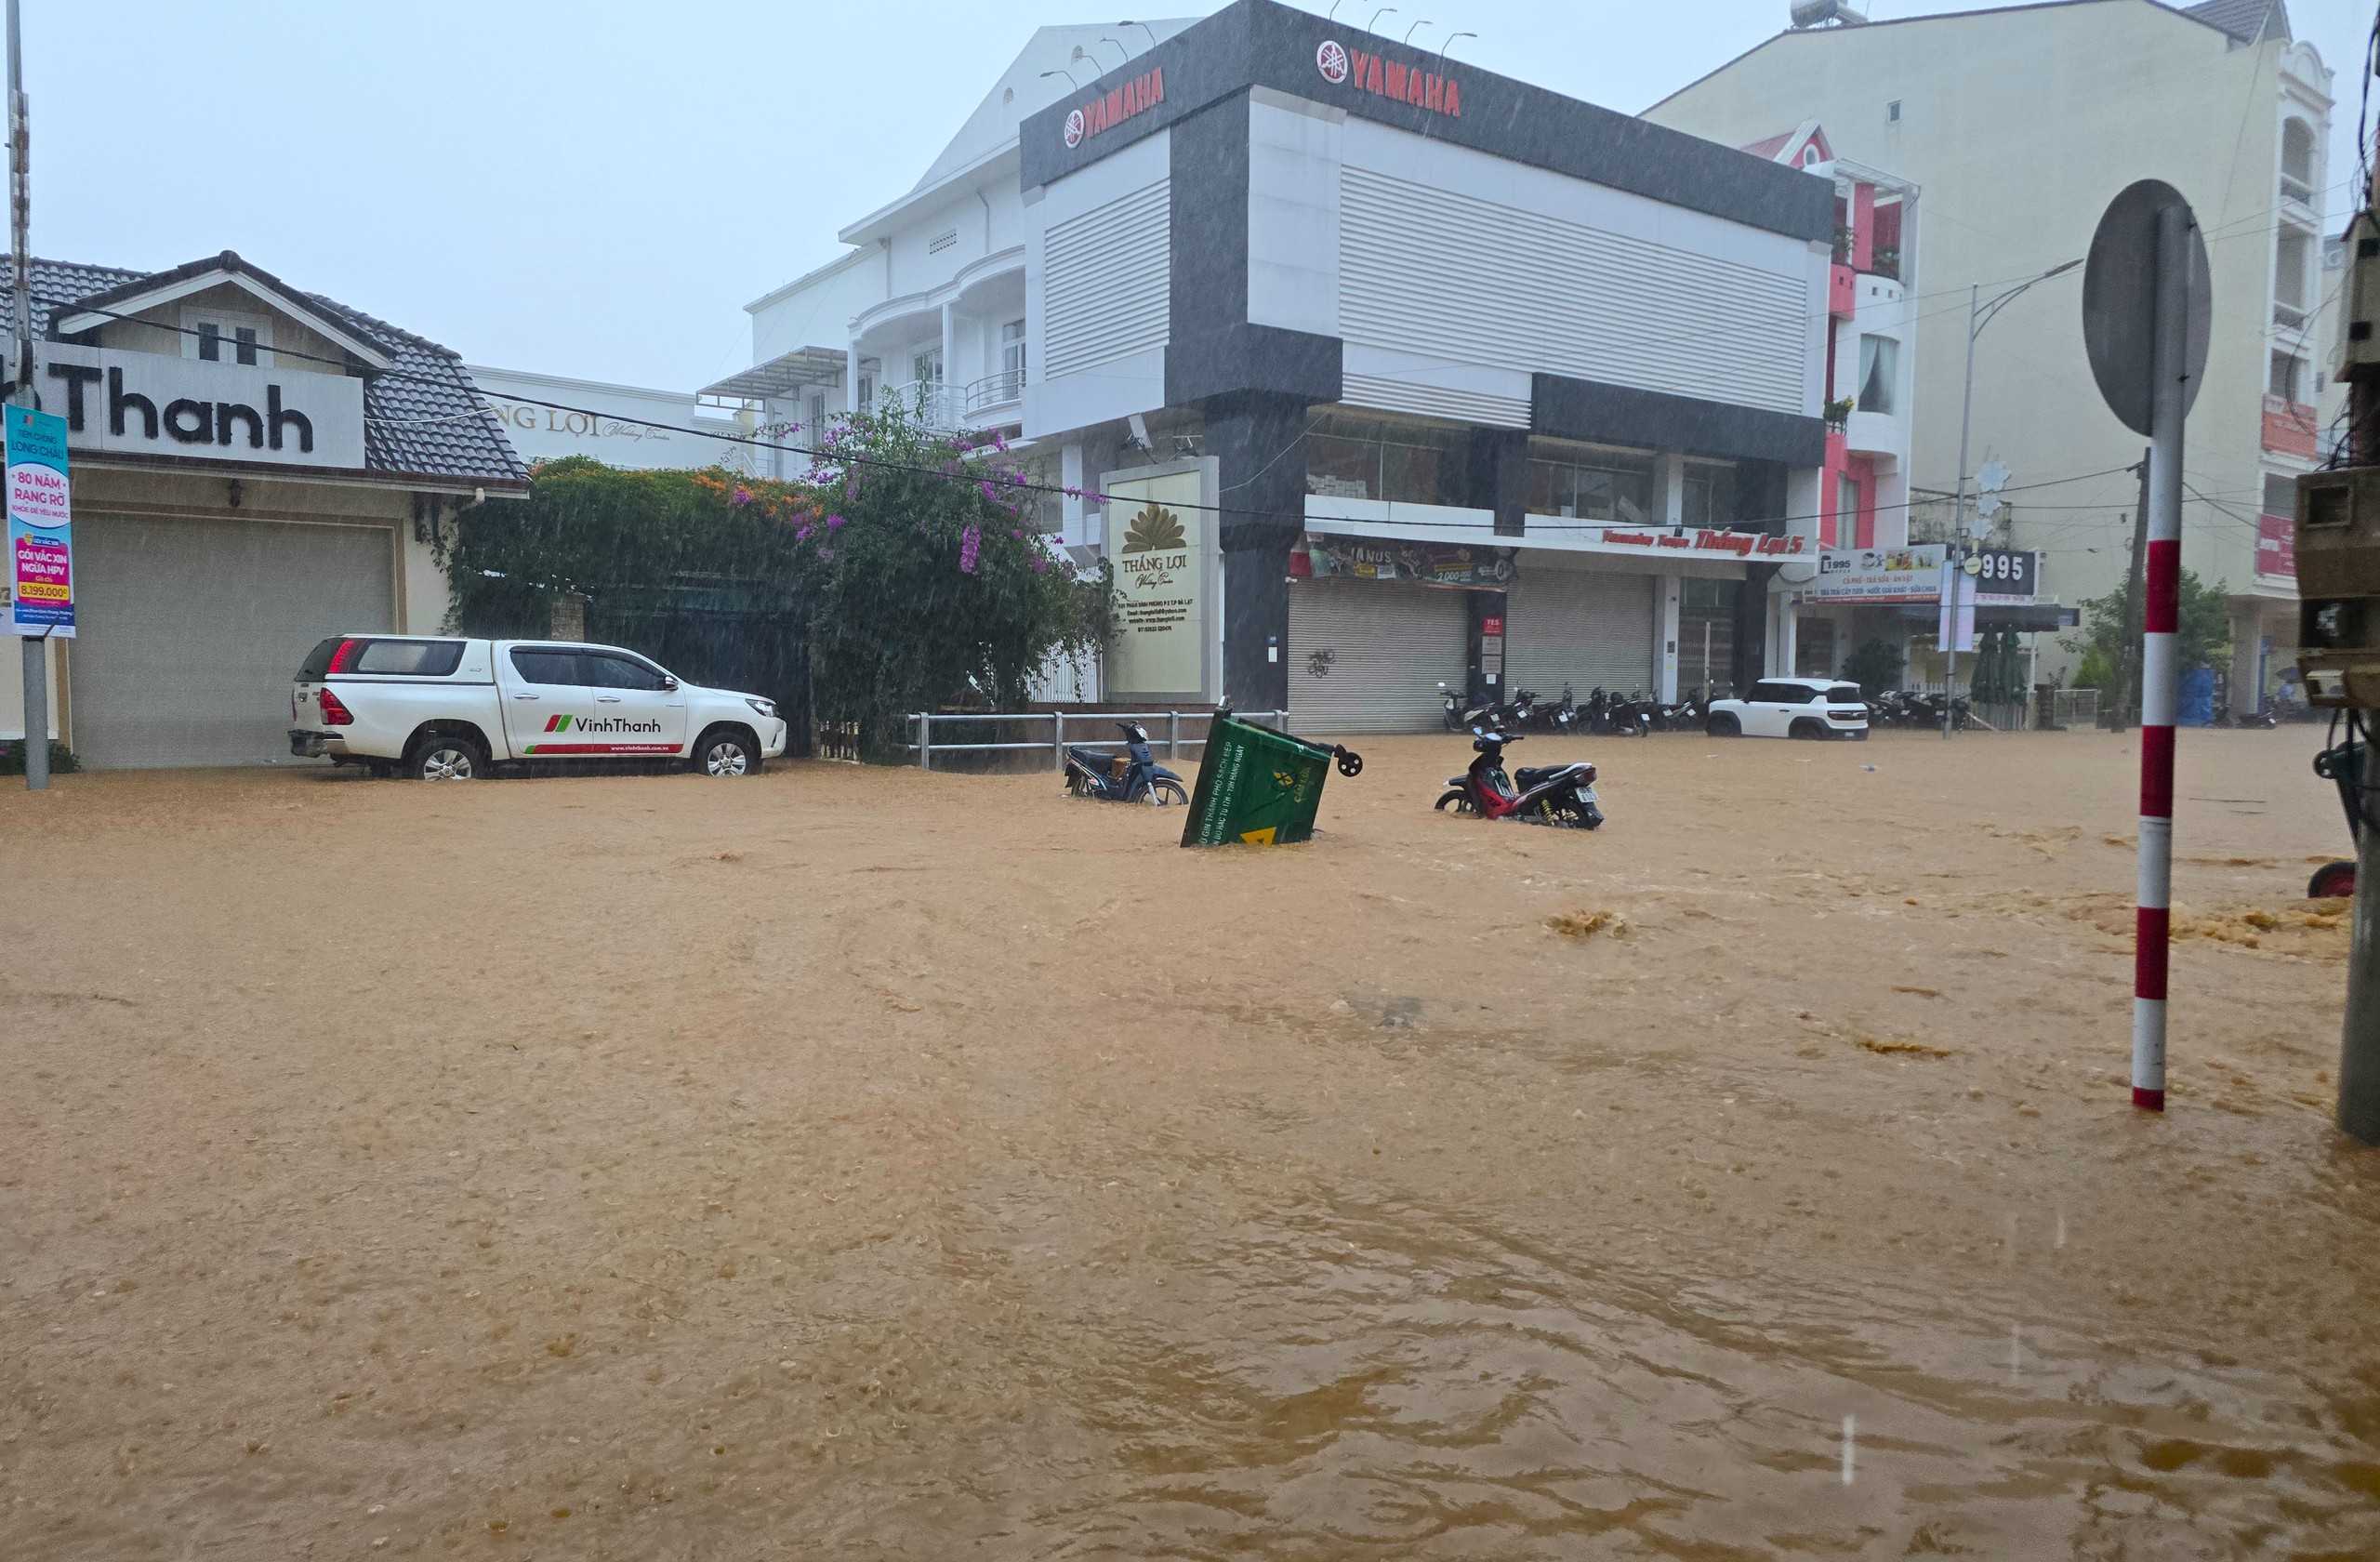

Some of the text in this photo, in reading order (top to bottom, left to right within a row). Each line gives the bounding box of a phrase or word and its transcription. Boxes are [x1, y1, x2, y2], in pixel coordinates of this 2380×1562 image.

[1350, 48, 1461, 117] YAMAHA
[1083, 66, 1164, 139] YAMAHA
[48, 362, 313, 453] Thanh
[546, 409, 601, 437] LỢI
[602, 422, 670, 442] Wedding Center
[11, 440, 37, 454] LONG
[18, 472, 60, 489] 80 NĂM
[14, 487, 46, 504] RẠNG
[1789, 536, 1805, 554] 5
[19, 549, 67, 563] GÓI VẮC XIN
[1827, 560, 1851, 568] 1995
[21, 561, 65, 576] NGỪA HPV
[1982, 553, 2024, 581] 995
[575, 718, 661, 733] VinhThanh
